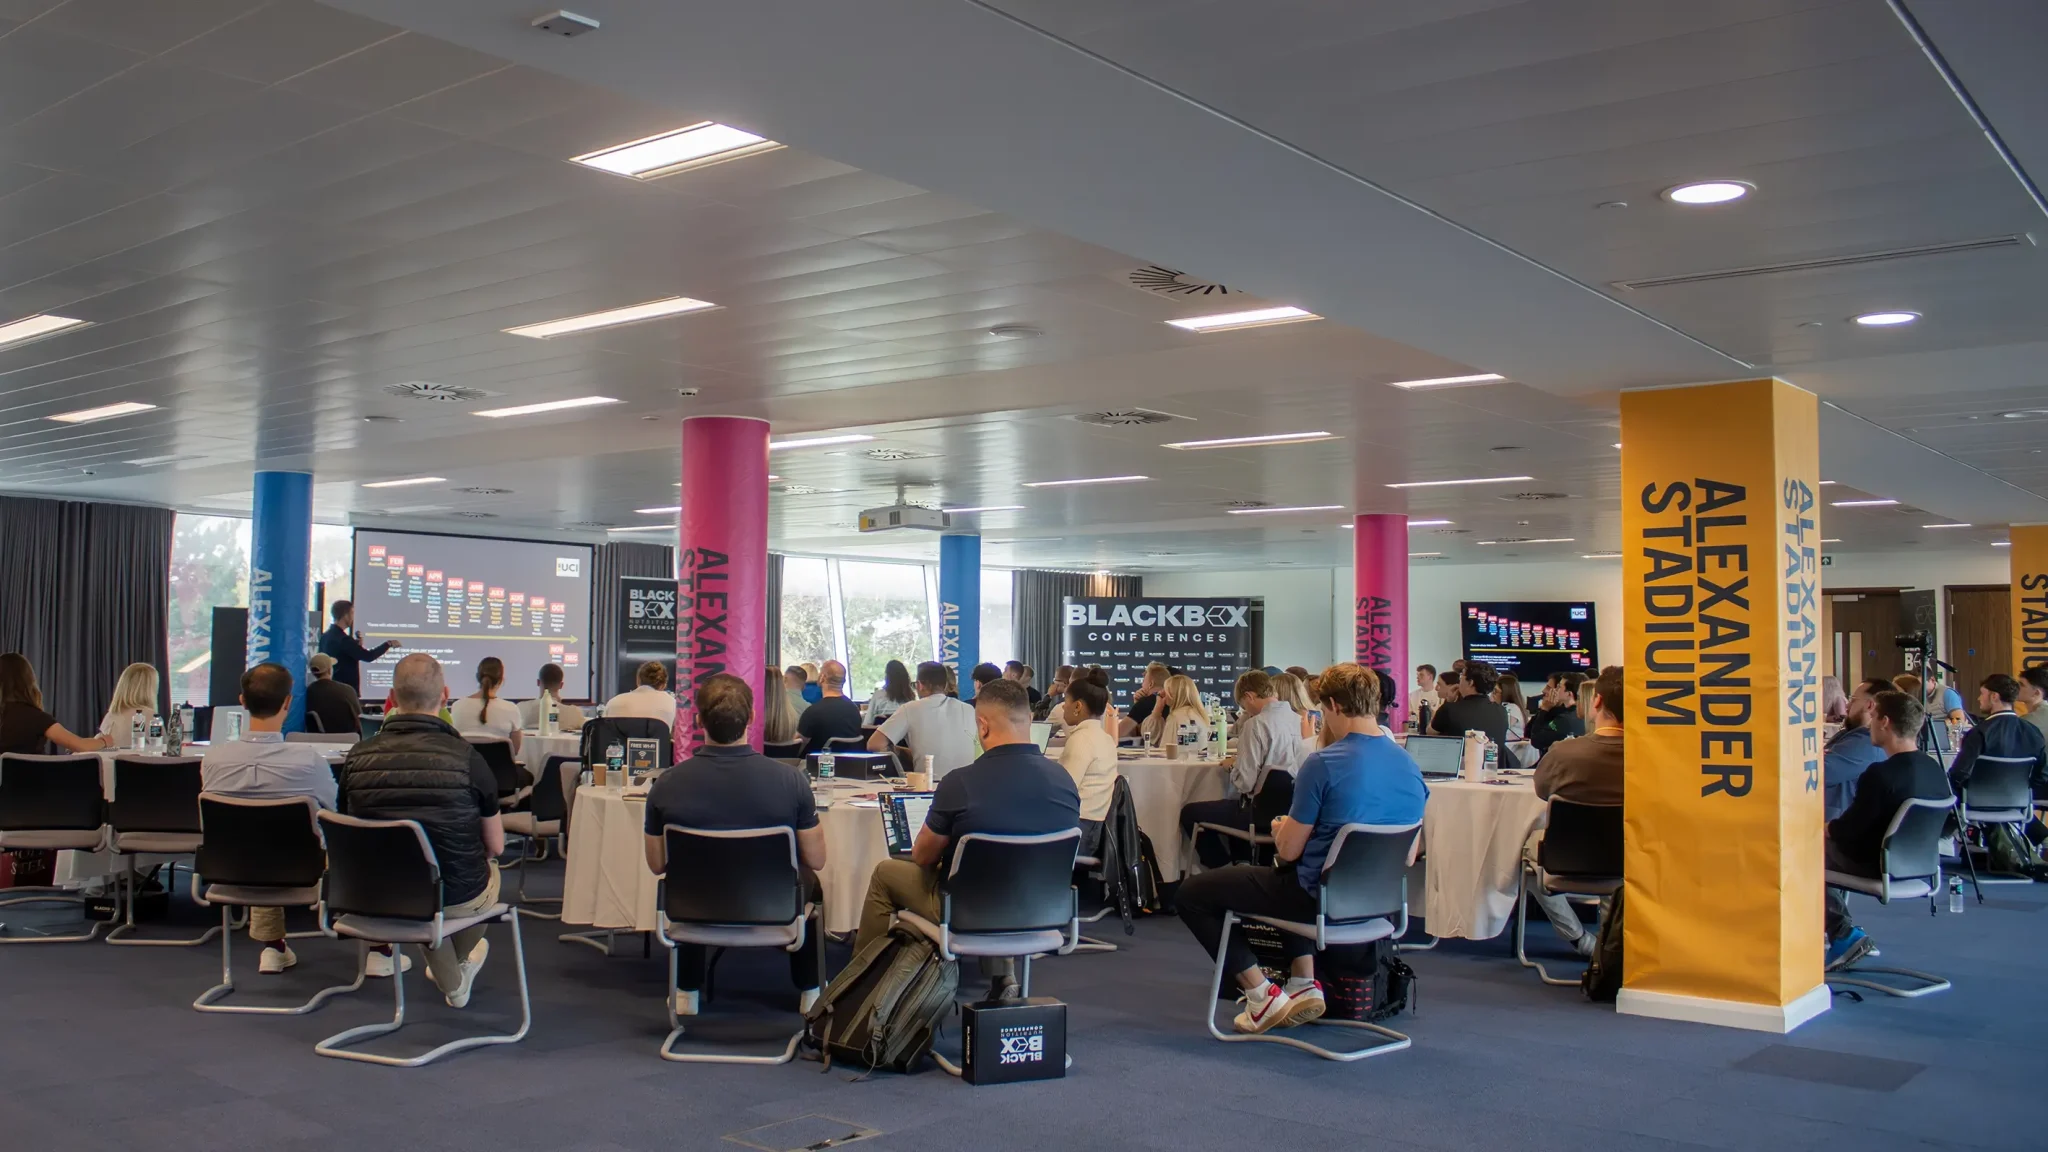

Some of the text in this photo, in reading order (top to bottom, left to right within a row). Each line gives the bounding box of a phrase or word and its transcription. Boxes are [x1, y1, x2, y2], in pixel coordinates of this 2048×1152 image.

[561, 563, 579, 572] UCI
[630, 589, 675, 601] BLACK
[1784, 476, 1802, 726] STADIUM
[248, 566, 272, 669] ALEXAN
[629, 600, 675, 619] BOX
[1066, 604, 1249, 628] BLACKBOX
[1088, 632, 1228, 643] CONFERENCES
[1356, 597, 1369, 666] STADI
[1370, 596, 1391, 674] ALEXA
[1641, 481, 1696, 726] STADIUM
[1695, 478, 1752, 797] ALEXANDER
[1798, 478, 1818, 794] ALEXANDER
[693, 547, 730, 741] ALEXAN
[943, 602, 959, 684] ALEXAN
[1000, 1025, 1043, 1034] CONFERENCE
[1000, 1035, 1043, 1054] BOX
[1000, 1052, 1043, 1065] BLACK
